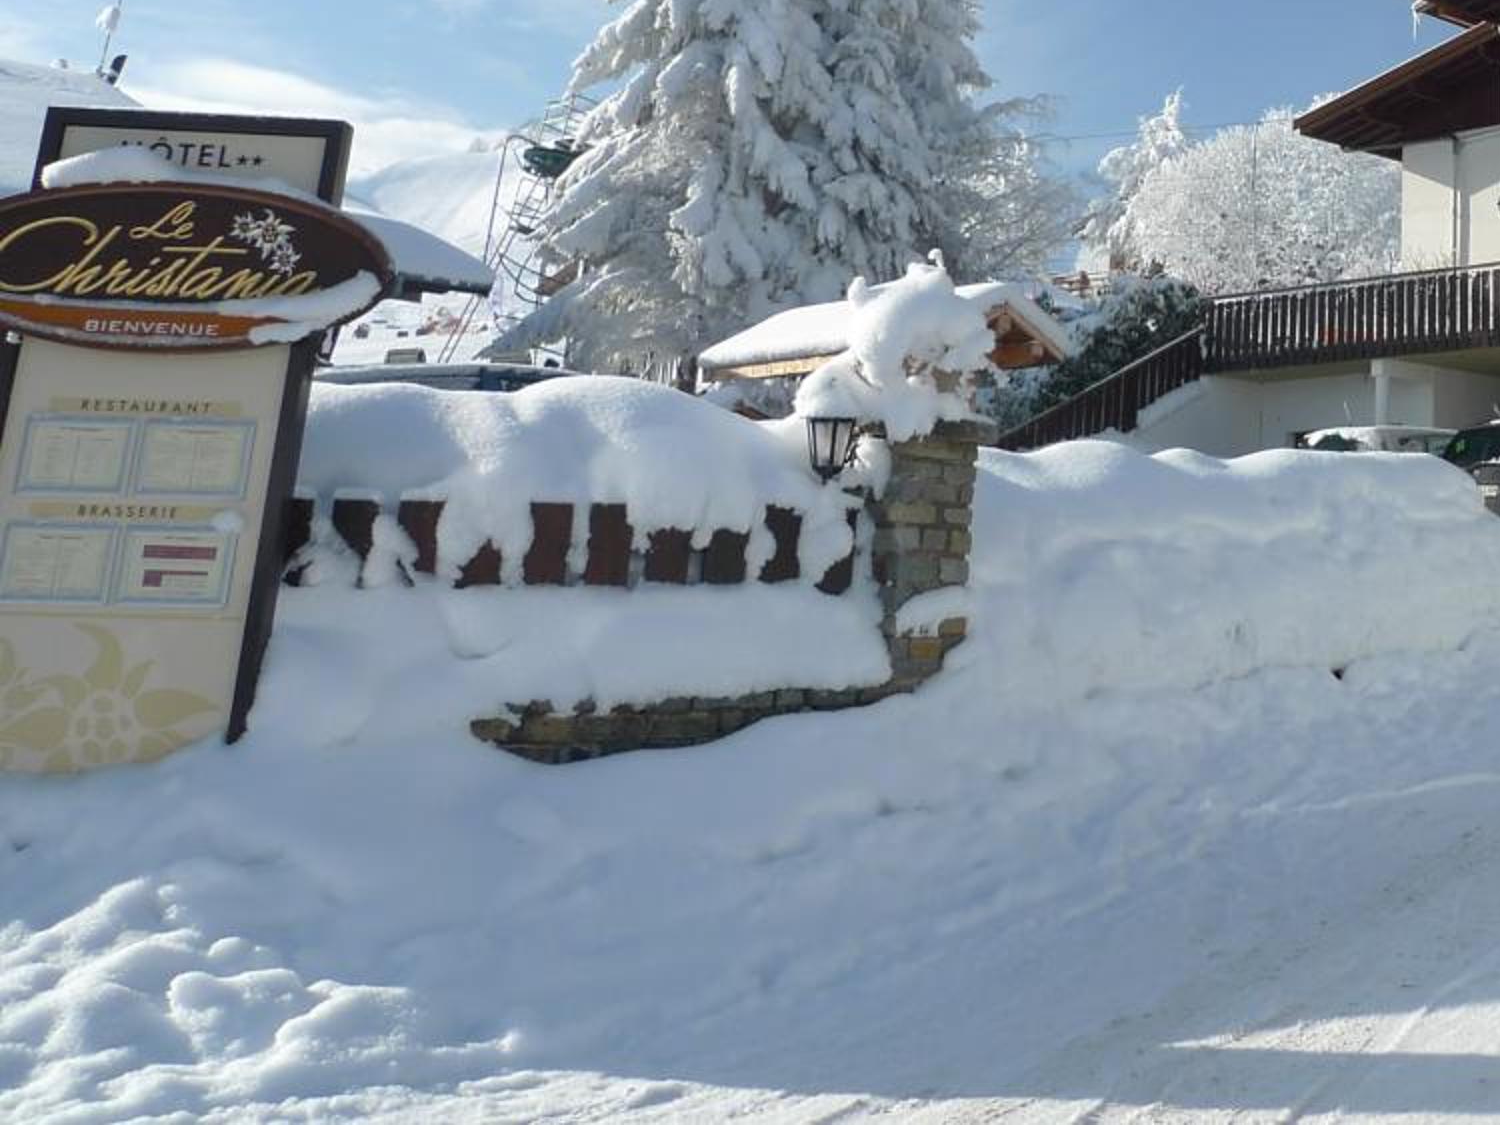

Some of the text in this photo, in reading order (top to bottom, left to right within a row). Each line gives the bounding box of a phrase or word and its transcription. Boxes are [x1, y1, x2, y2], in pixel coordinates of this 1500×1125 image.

[121, 136, 232, 168] ÔTEL
[129, 200, 197, 239] Le
[0, 216, 320, 298] Christania
[84, 319, 221, 336] BIENVENUE
[80, 398, 213, 414] RESTAURANT
[76, 504, 178, 519] BRASSERIE
